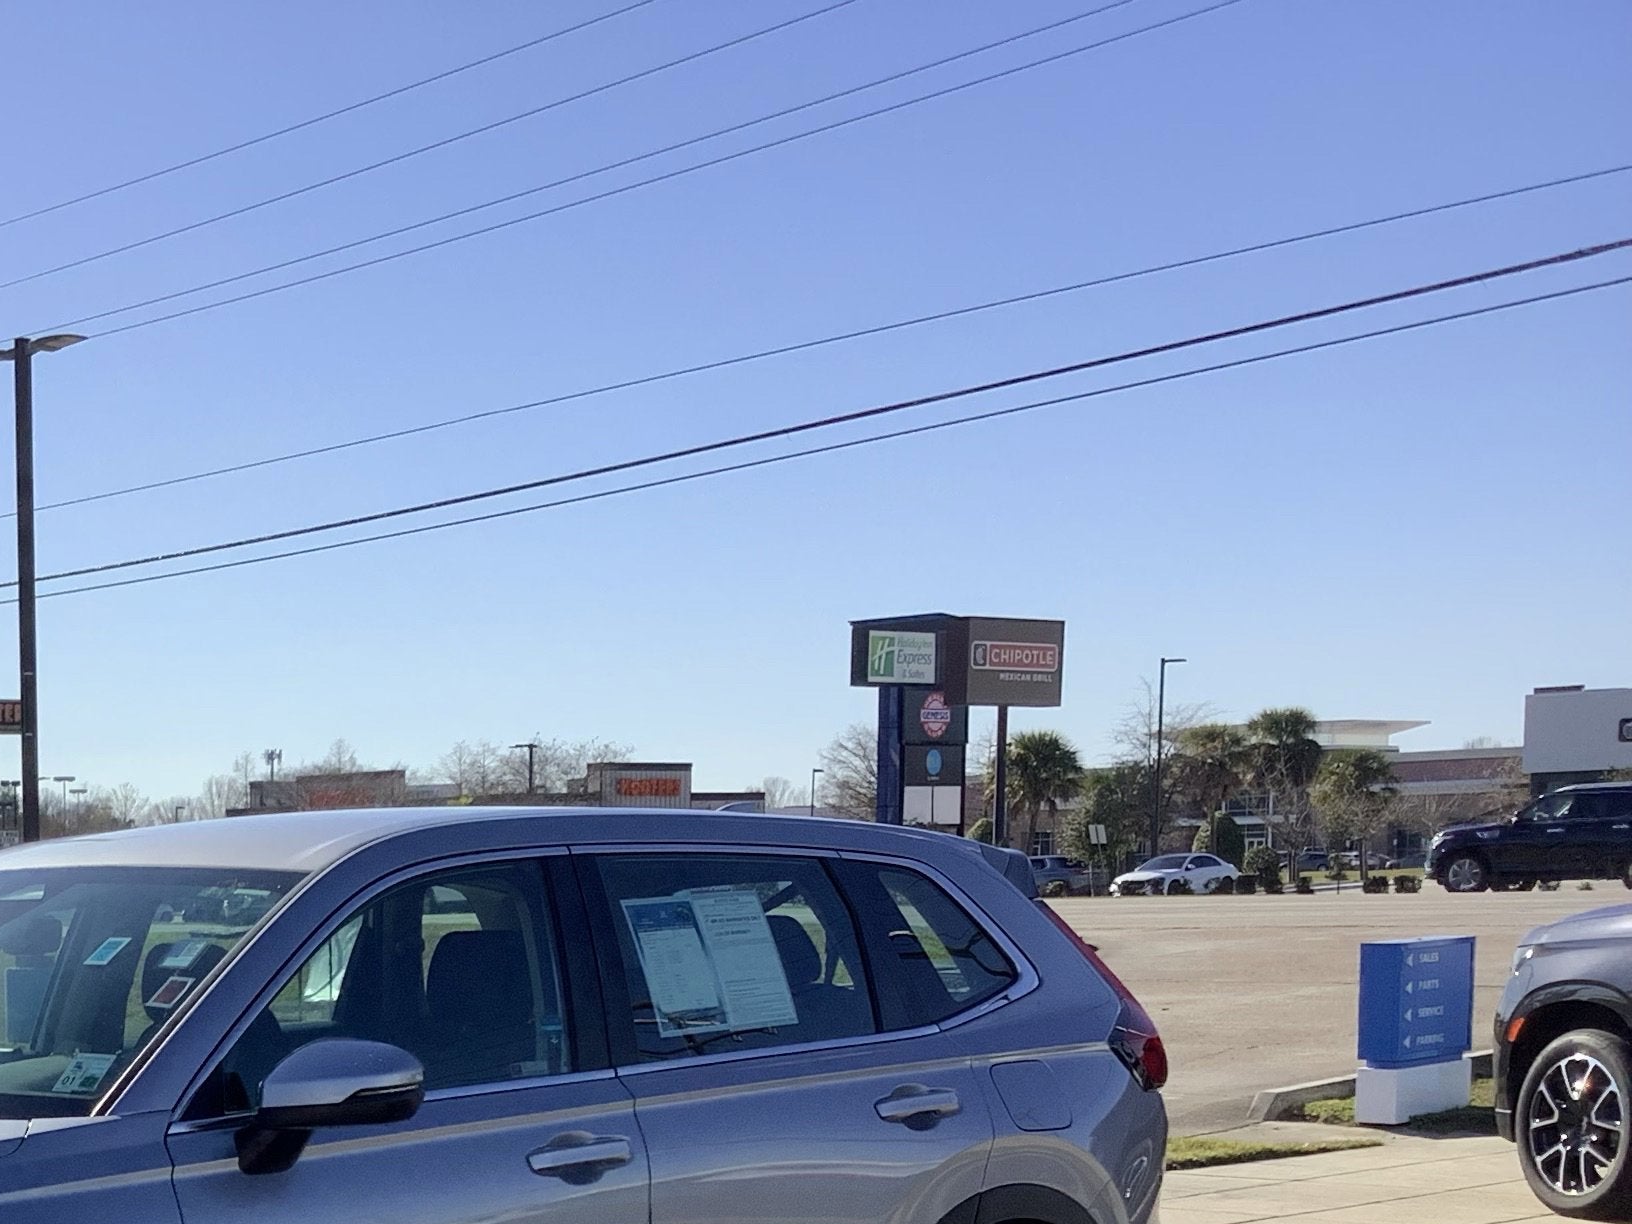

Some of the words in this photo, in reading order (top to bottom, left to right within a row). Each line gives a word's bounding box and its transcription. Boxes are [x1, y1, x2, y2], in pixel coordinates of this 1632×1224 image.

[897, 649, 932, 668] Express
[991, 648, 1055, 665] CHIPOTLE
[999, 672, 1032, 682] MEXICAN
[1032, 673, 1053, 683] GRILL
[1419, 952, 1440, 963] SALES
[1418, 978, 1439, 990] PARTS
[1418, 1005, 1444, 1018] SERVICE
[1416, 1033, 1444, 1046] PARKING
